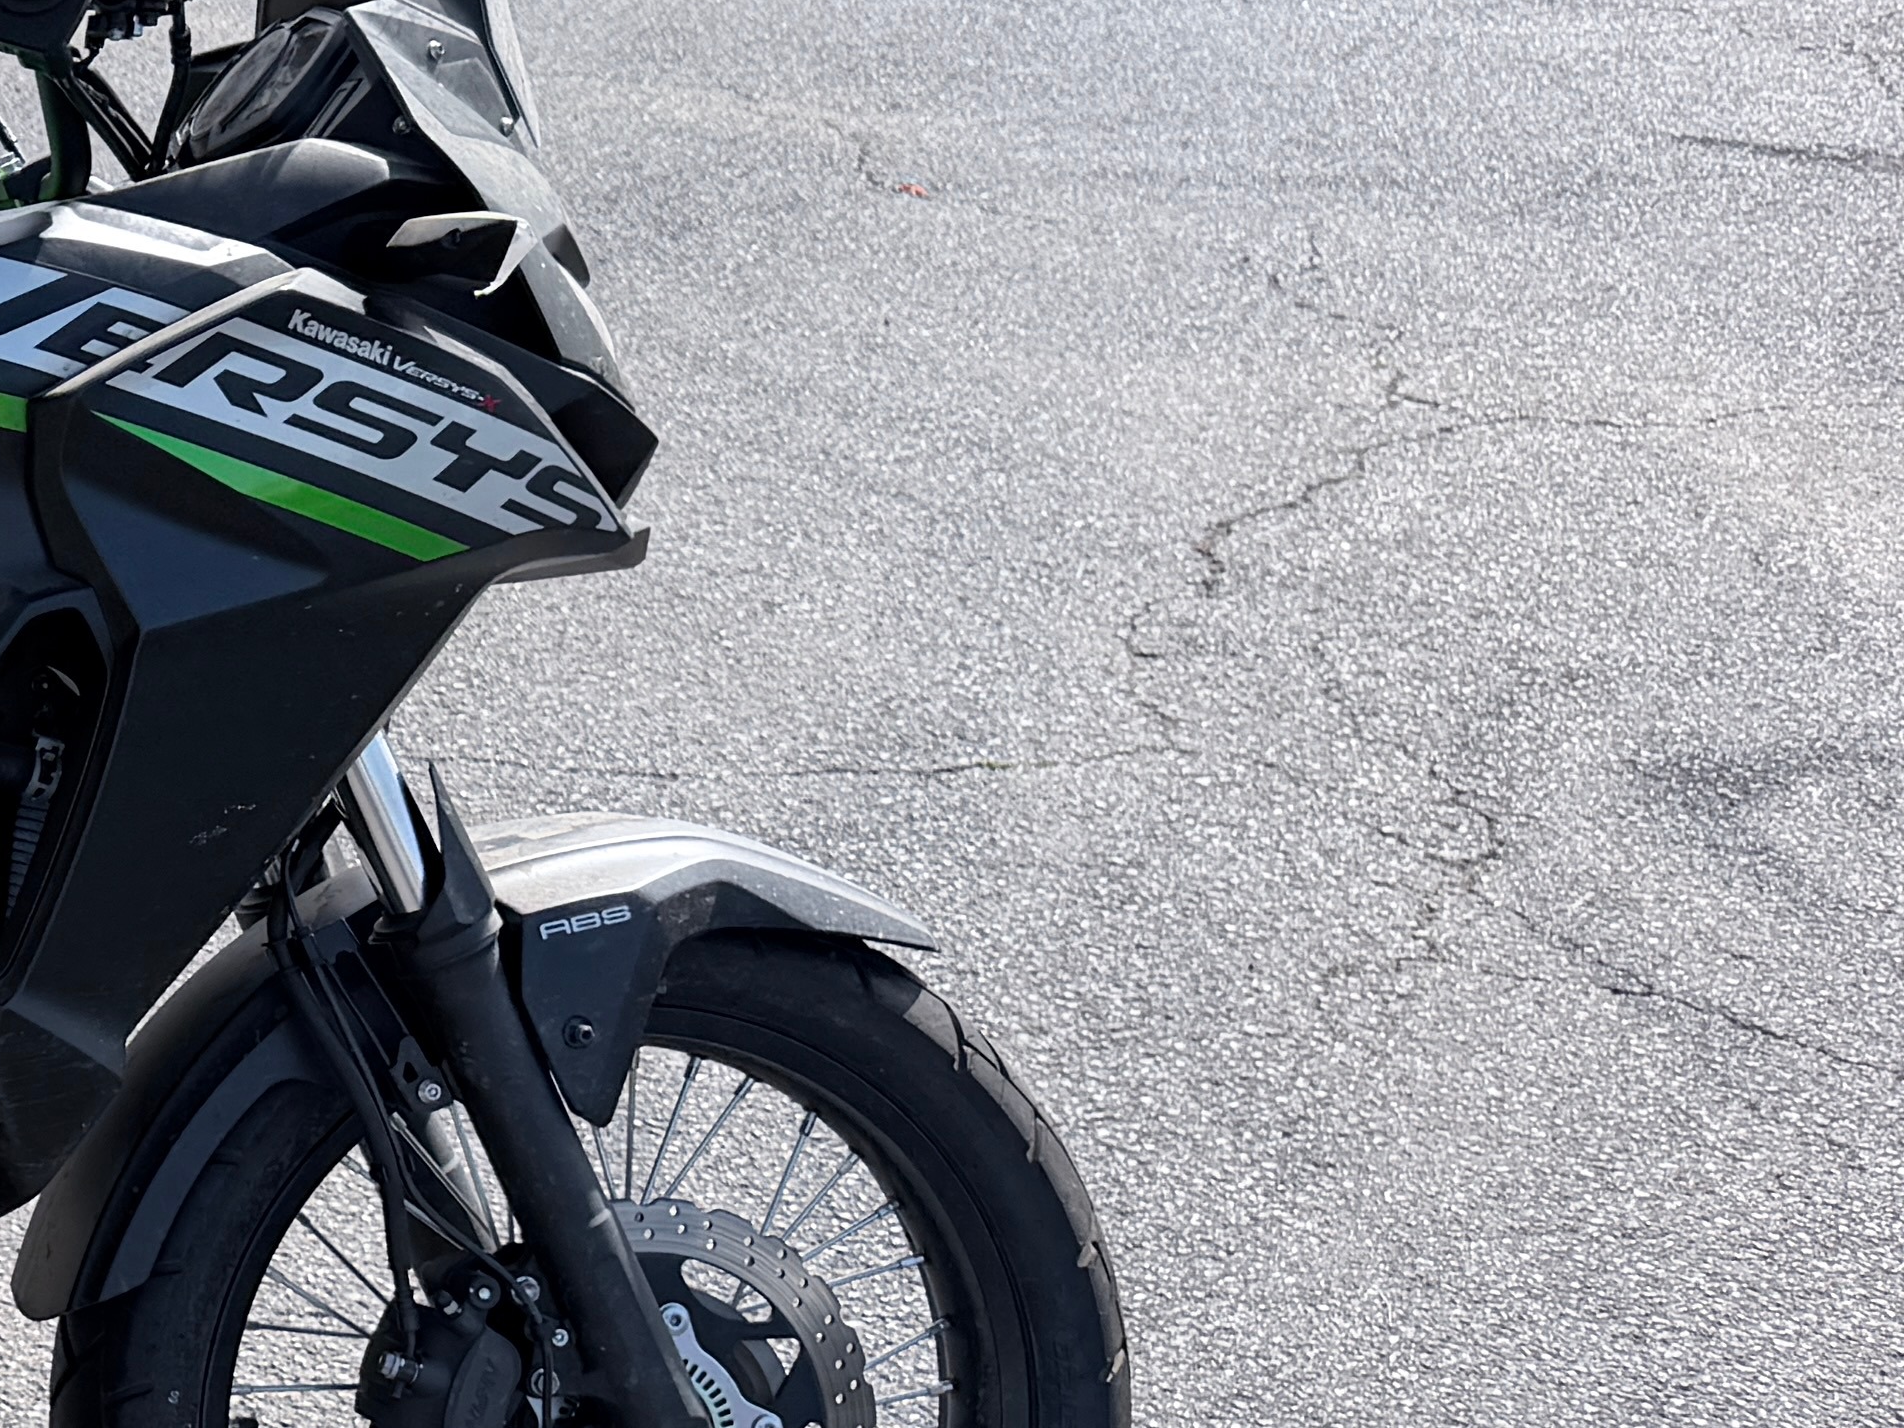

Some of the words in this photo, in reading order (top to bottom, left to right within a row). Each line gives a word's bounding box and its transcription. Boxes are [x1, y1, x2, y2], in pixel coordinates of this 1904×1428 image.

[288, 309, 392, 366] Kawasaki
[393, 355, 501, 412] VERSYS-X
[539, 905, 632, 940] ABS
